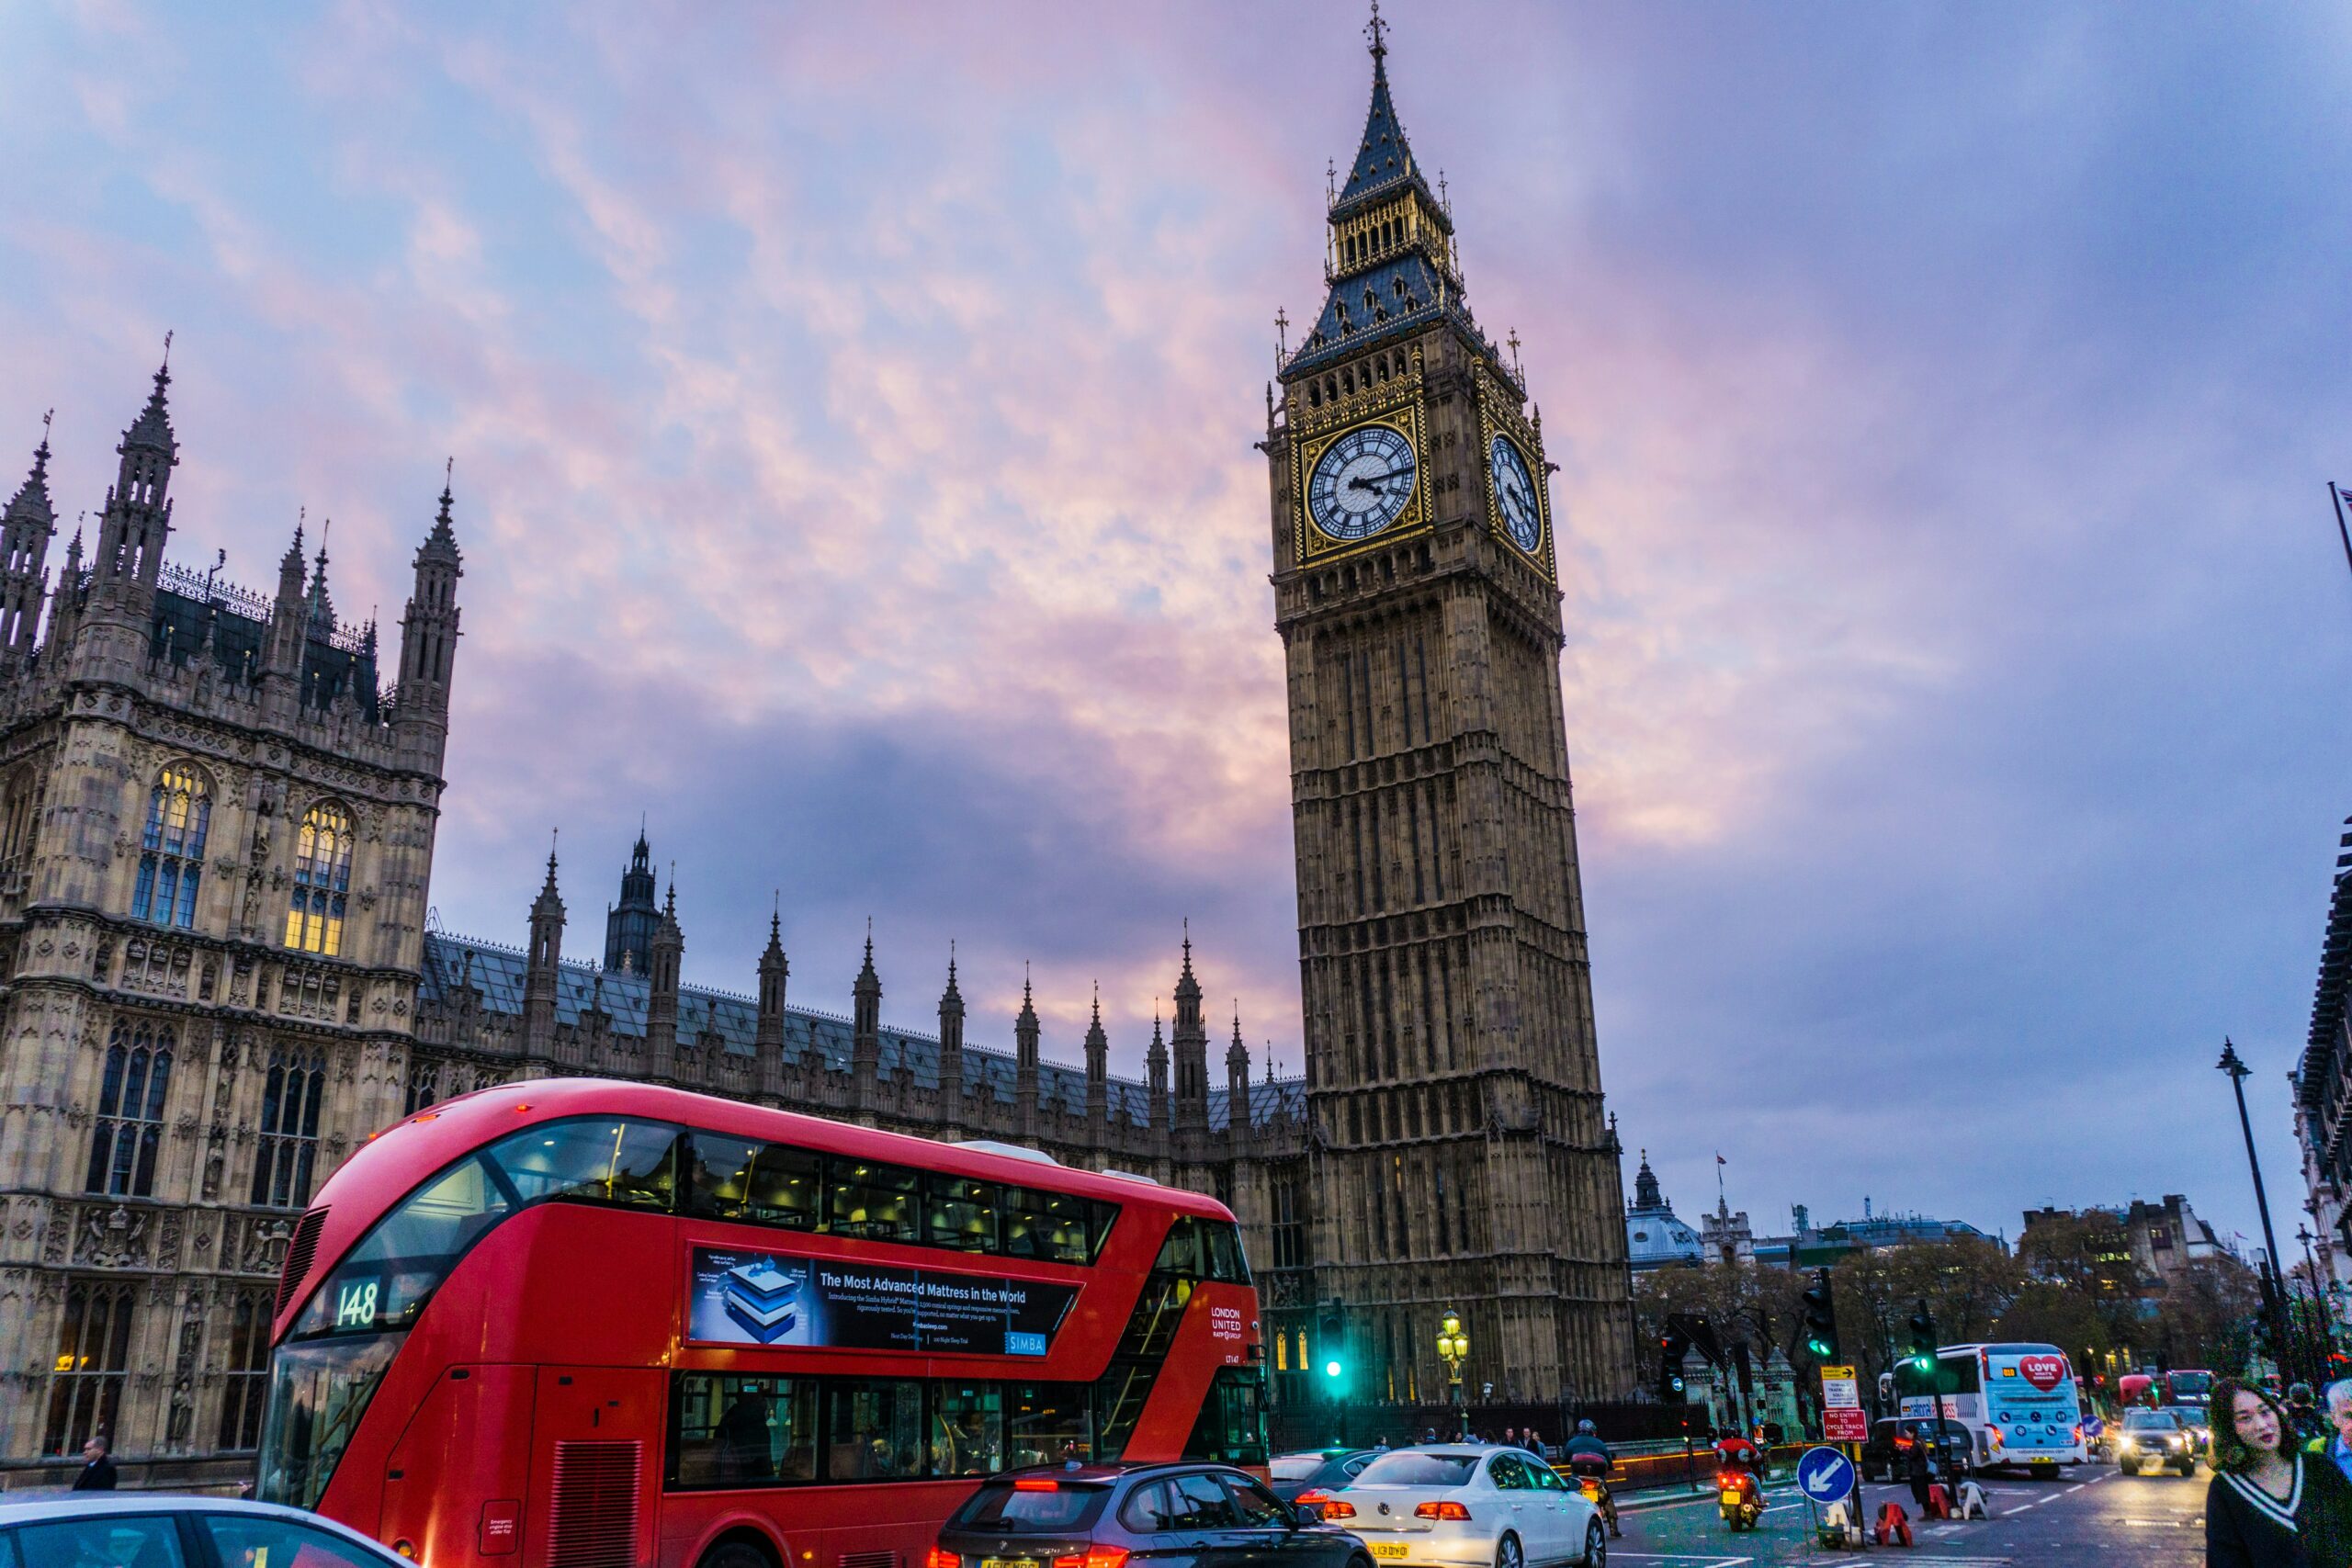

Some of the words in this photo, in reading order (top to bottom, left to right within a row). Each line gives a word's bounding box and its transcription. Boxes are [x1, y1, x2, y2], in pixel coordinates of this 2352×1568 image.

[820, 1273, 841, 1286] The
[844, 1275, 871, 1289] Most
[873, 1278, 924, 1295] Advanced
[927, 1284, 968, 1299] Mattress
[971, 1287, 979, 1300] in
[982, 1288, 997, 1301] the
[999, 1291, 1026, 1303] World
[828, 1292, 856, 1302] Introducing
[338, 1283, 377, 1326] 148
[1211, 1307, 1240, 1319] LONDON
[1213, 1320, 1241, 1331] UNITED
[1011, 1336, 1042, 1351] SIMBA
[2028, 1364, 2057, 1372] LOVE
